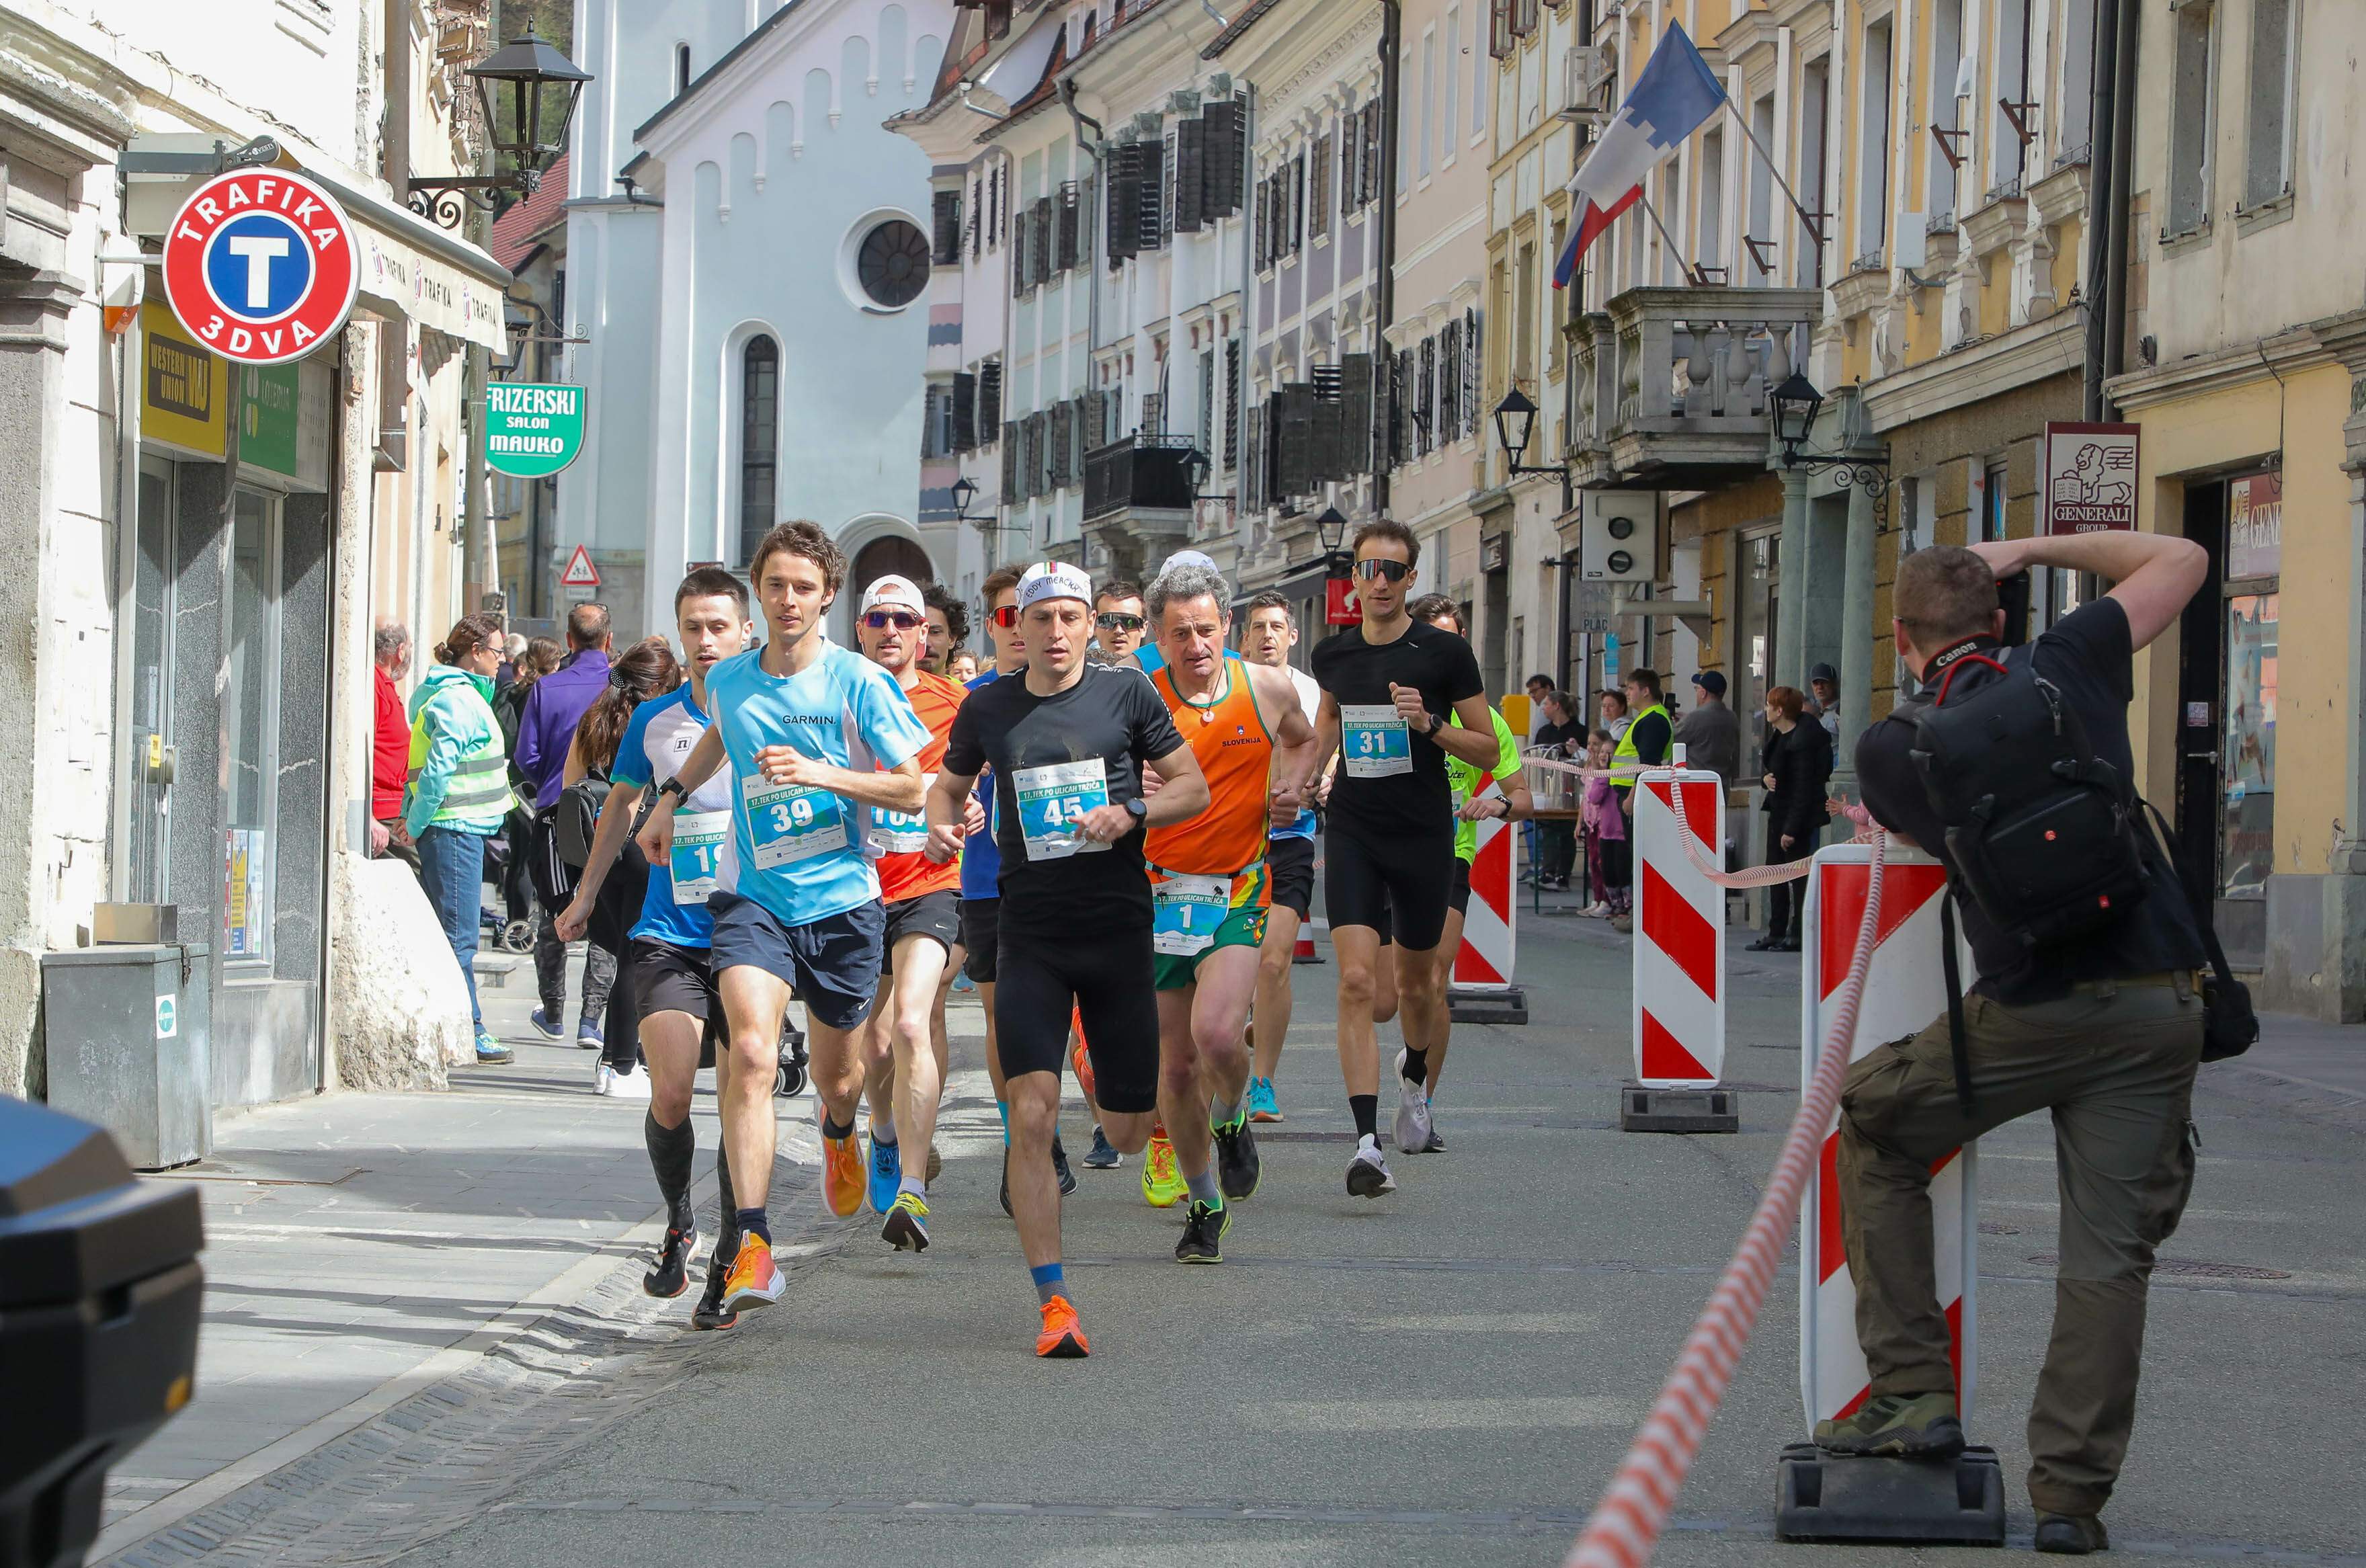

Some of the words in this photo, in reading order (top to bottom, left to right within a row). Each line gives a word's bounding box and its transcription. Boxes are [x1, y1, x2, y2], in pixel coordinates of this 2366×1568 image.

[177, 179, 338, 251] TRAFIKA
[230, 237, 289, 308] T
[382, 253, 406, 287] TRAFIKA
[424, 277, 452, 309] TRAFIKA
[151, 343, 185, 377] WESTERN
[161, 374, 184, 404] UNION
[487, 387, 575, 415] FRIZERSKI
[506, 415, 550, 429] SALON
[489, 435, 564, 454] MAUKO
[2054, 506, 2129, 522] GENERALI
[2076, 524, 2108, 532] GROUP
[1026, 581, 1042, 597] EDDY
[1584, 618, 1608, 630] PLAC
[1936, 642, 1977, 667] Canon
[1222, 737, 1261, 747] SLOVENIJA
[1360, 731, 1385, 753] 31
[760, 796, 770, 804] TEK
[771, 793, 780, 801] PO
[780, 786, 803, 799] ULICAH
[1032, 790, 1043, 798] TEK
[1055, 786, 1077, 795] ULICAH
[1078, 781, 1100, 791] TRŽIČA
[770, 798, 813, 833] 39
[1043, 796, 1084, 827] 45
[1180, 904, 1192, 928] 1
